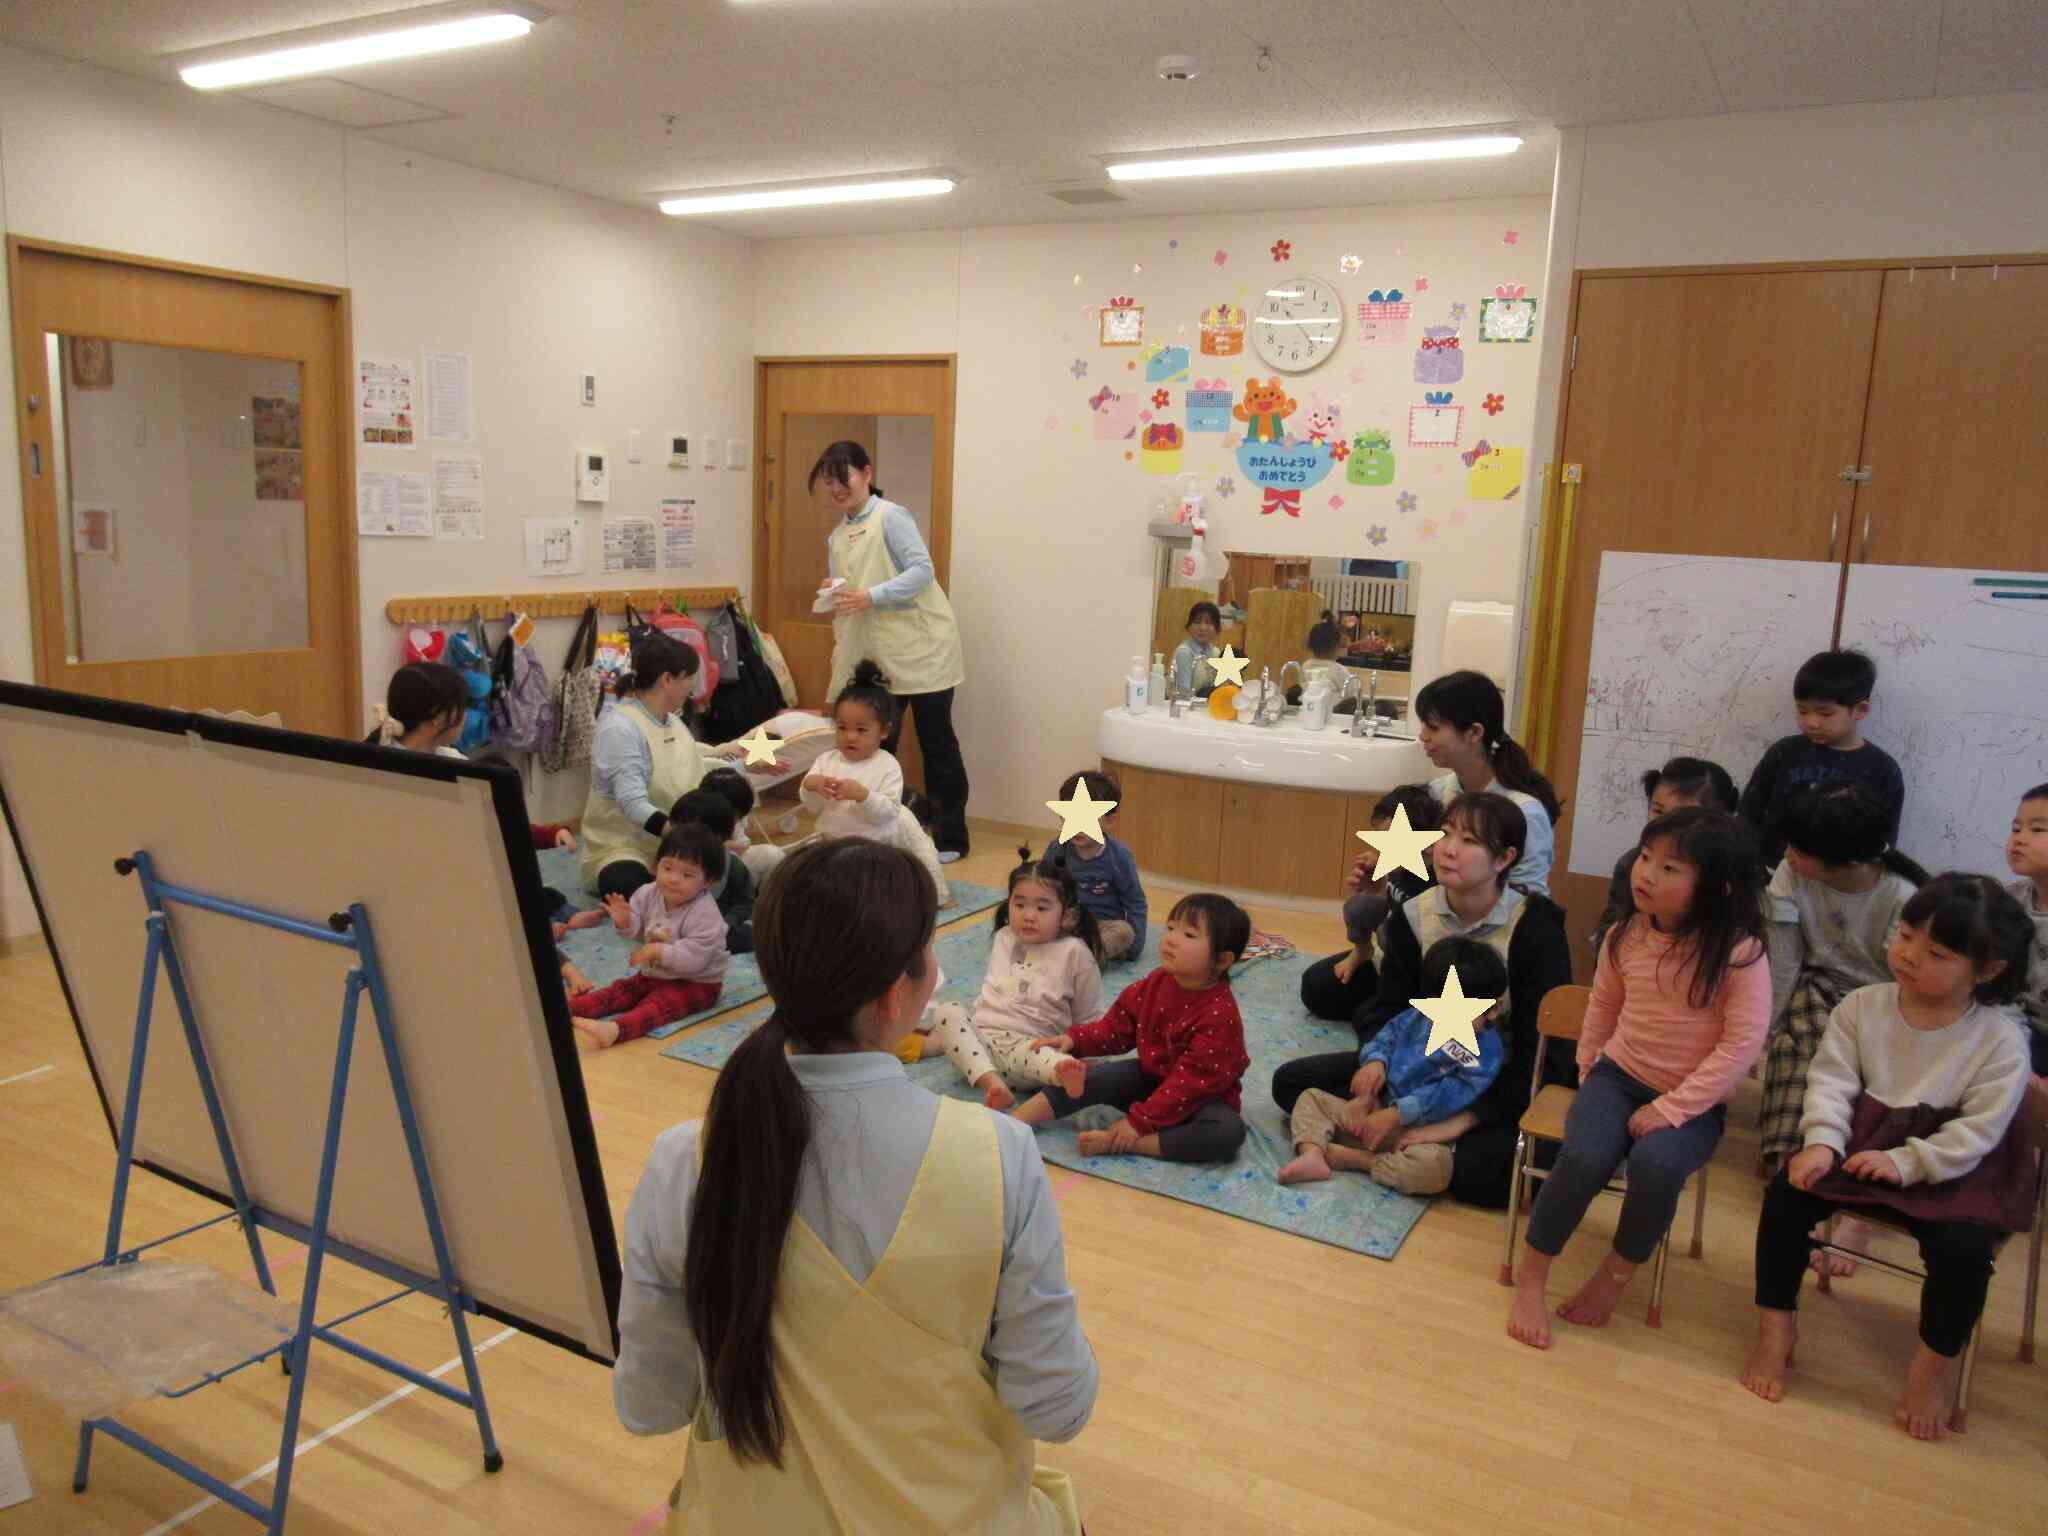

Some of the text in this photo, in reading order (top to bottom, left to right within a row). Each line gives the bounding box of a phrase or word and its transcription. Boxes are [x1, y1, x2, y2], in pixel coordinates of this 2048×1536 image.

[1270, 303, 1279, 313] 10
[1248, 455, 1317, 468] おたんじょうび
[1258, 470, 1306, 482] おめでとう
